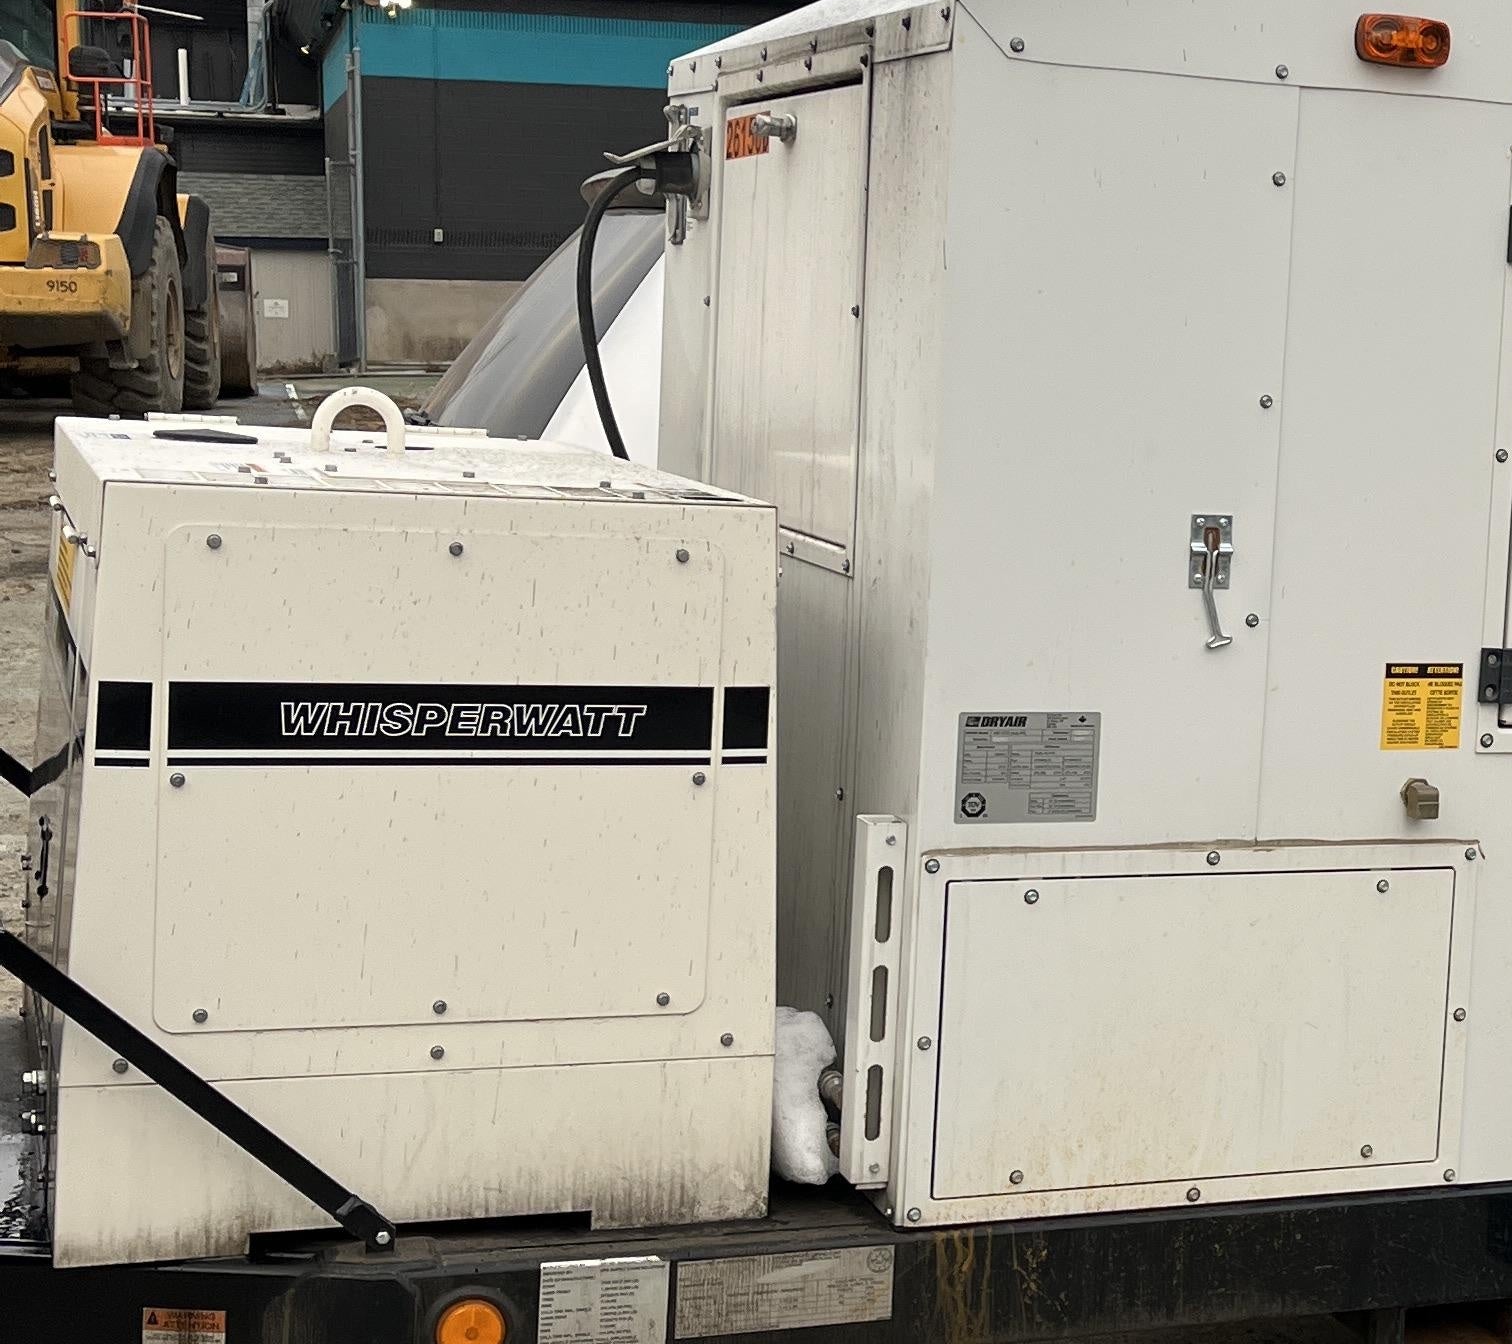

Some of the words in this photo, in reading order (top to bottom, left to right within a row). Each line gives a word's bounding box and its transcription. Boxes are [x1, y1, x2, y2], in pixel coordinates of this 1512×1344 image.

[46, 280, 78, 293] 9150
[281, 702, 647, 737] WHISPERWATT
[981, 716, 1028, 727] DRYAIR
